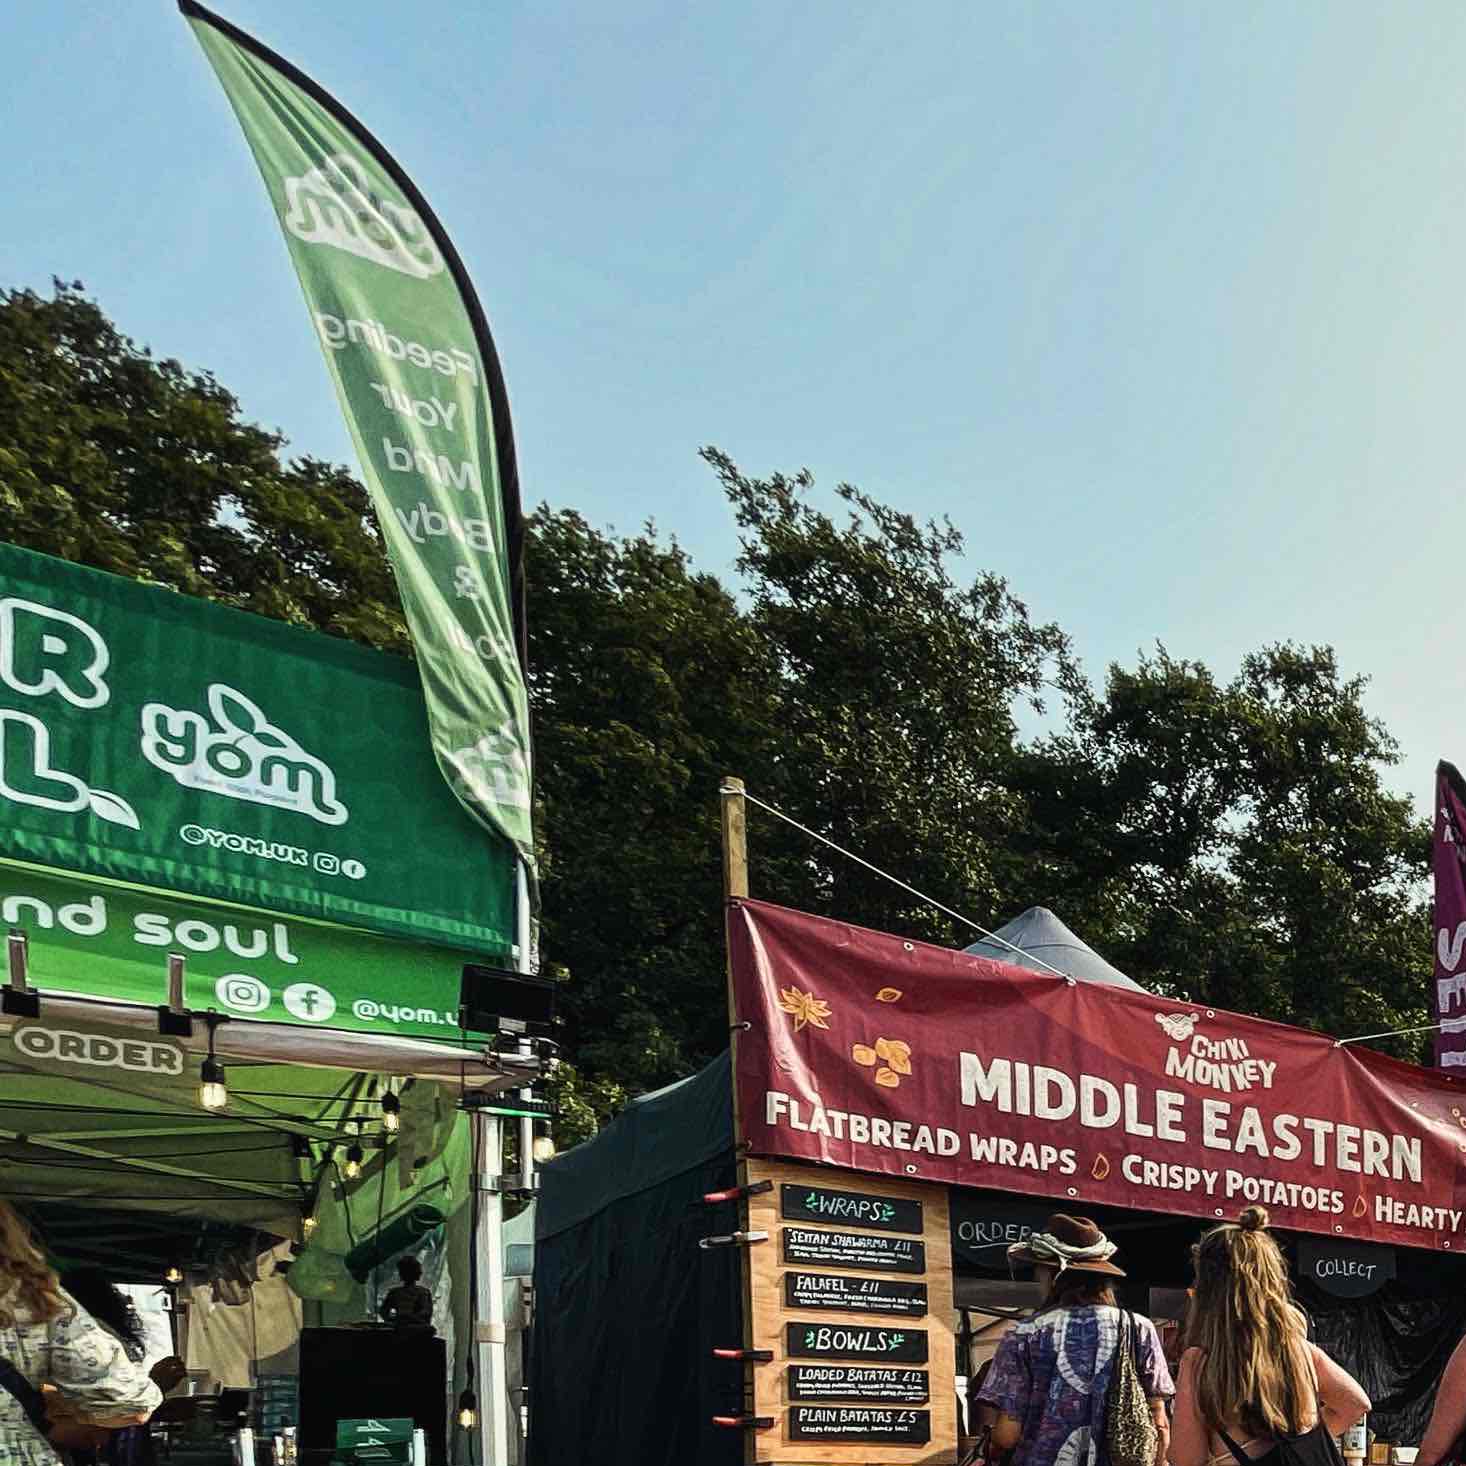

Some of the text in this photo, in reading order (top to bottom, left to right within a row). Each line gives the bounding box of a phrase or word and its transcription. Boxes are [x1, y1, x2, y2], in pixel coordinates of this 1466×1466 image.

[141, 700, 349, 826] yom
[133, 911, 299, 966] soul
[352, 999, 459, 1026] @yom.u
[13, 1026, 184, 1075] ORDER
[1191, 1034, 1249, 1061] CHIKI
[1165, 1046, 1277, 1093] MONKEY
[959, 1051, 1423, 1183] MIDDLE EASTERN
[765, 1090, 961, 1158] FLATBREAD
[969, 1133, 1078, 1175] WRAPS
[1121, 1154, 1219, 1194] CRISPY
[1225, 1169, 1345, 1214] POTATOES
[1375, 1195, 1462, 1234] HEARTY
[819, 1195, 882, 1221] WRAPS
[789, 1230, 830, 1246] SEITAN
[1315, 1257, 1377, 1282] COLLECT
[795, 1275, 849, 1293] FALAFEL
[860, 1280, 879, 1294] £11
[815, 1327, 888, 1352] BOWLS
[798, 1368, 922, 1383] LOADED BATATAS £12
[798, 1408, 837, 1423] PLAIN
[839, 1409, 892, 1424] BATATAS
